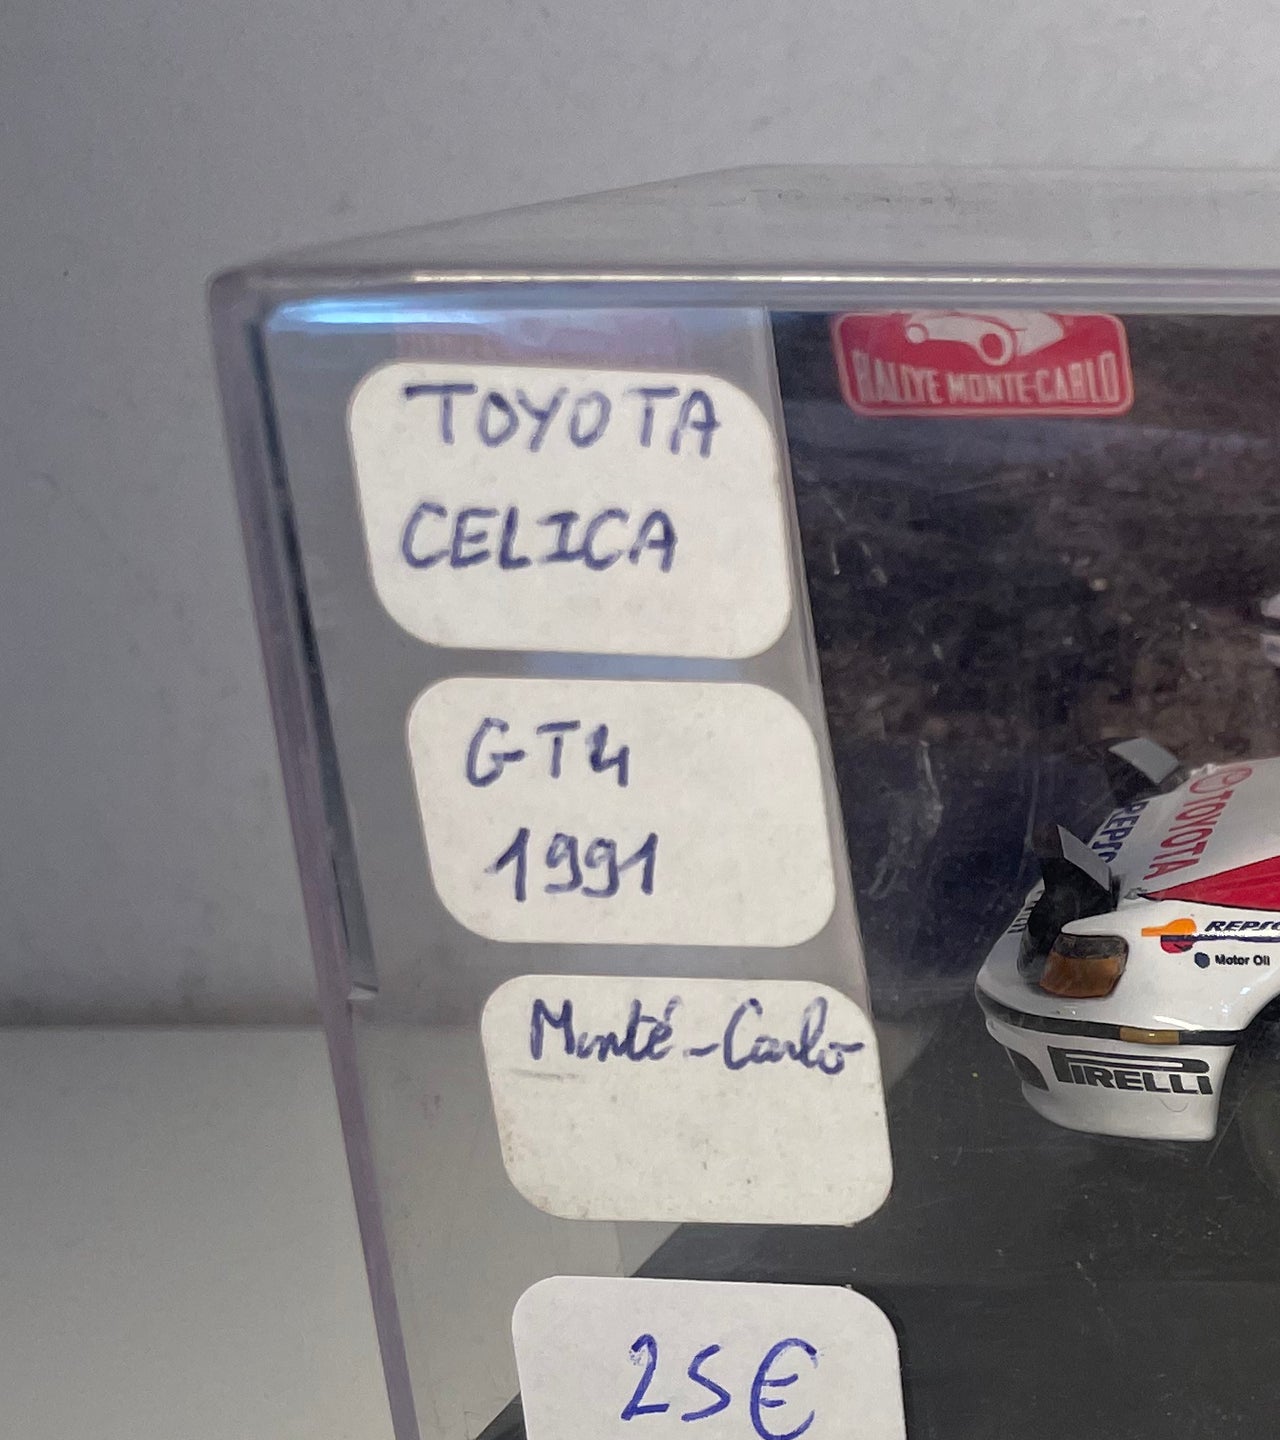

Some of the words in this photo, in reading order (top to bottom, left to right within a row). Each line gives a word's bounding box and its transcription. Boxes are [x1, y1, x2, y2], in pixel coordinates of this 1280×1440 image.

[851, 348, 943, 404] RALLYE
[946, 350, 1120, 404] MONTE-CARLO
[403, 382, 722, 458] TOYOTA
[400, 501, 679, 573] CELICA
[464, 717, 631, 788] GT4
[483, 827, 660, 903] 1991
[1142, 789, 1235, 881] TOYOTA
[1214, 954, 1250, 966] Motor
[1047, 1045, 1213, 1095] PIRELLI
